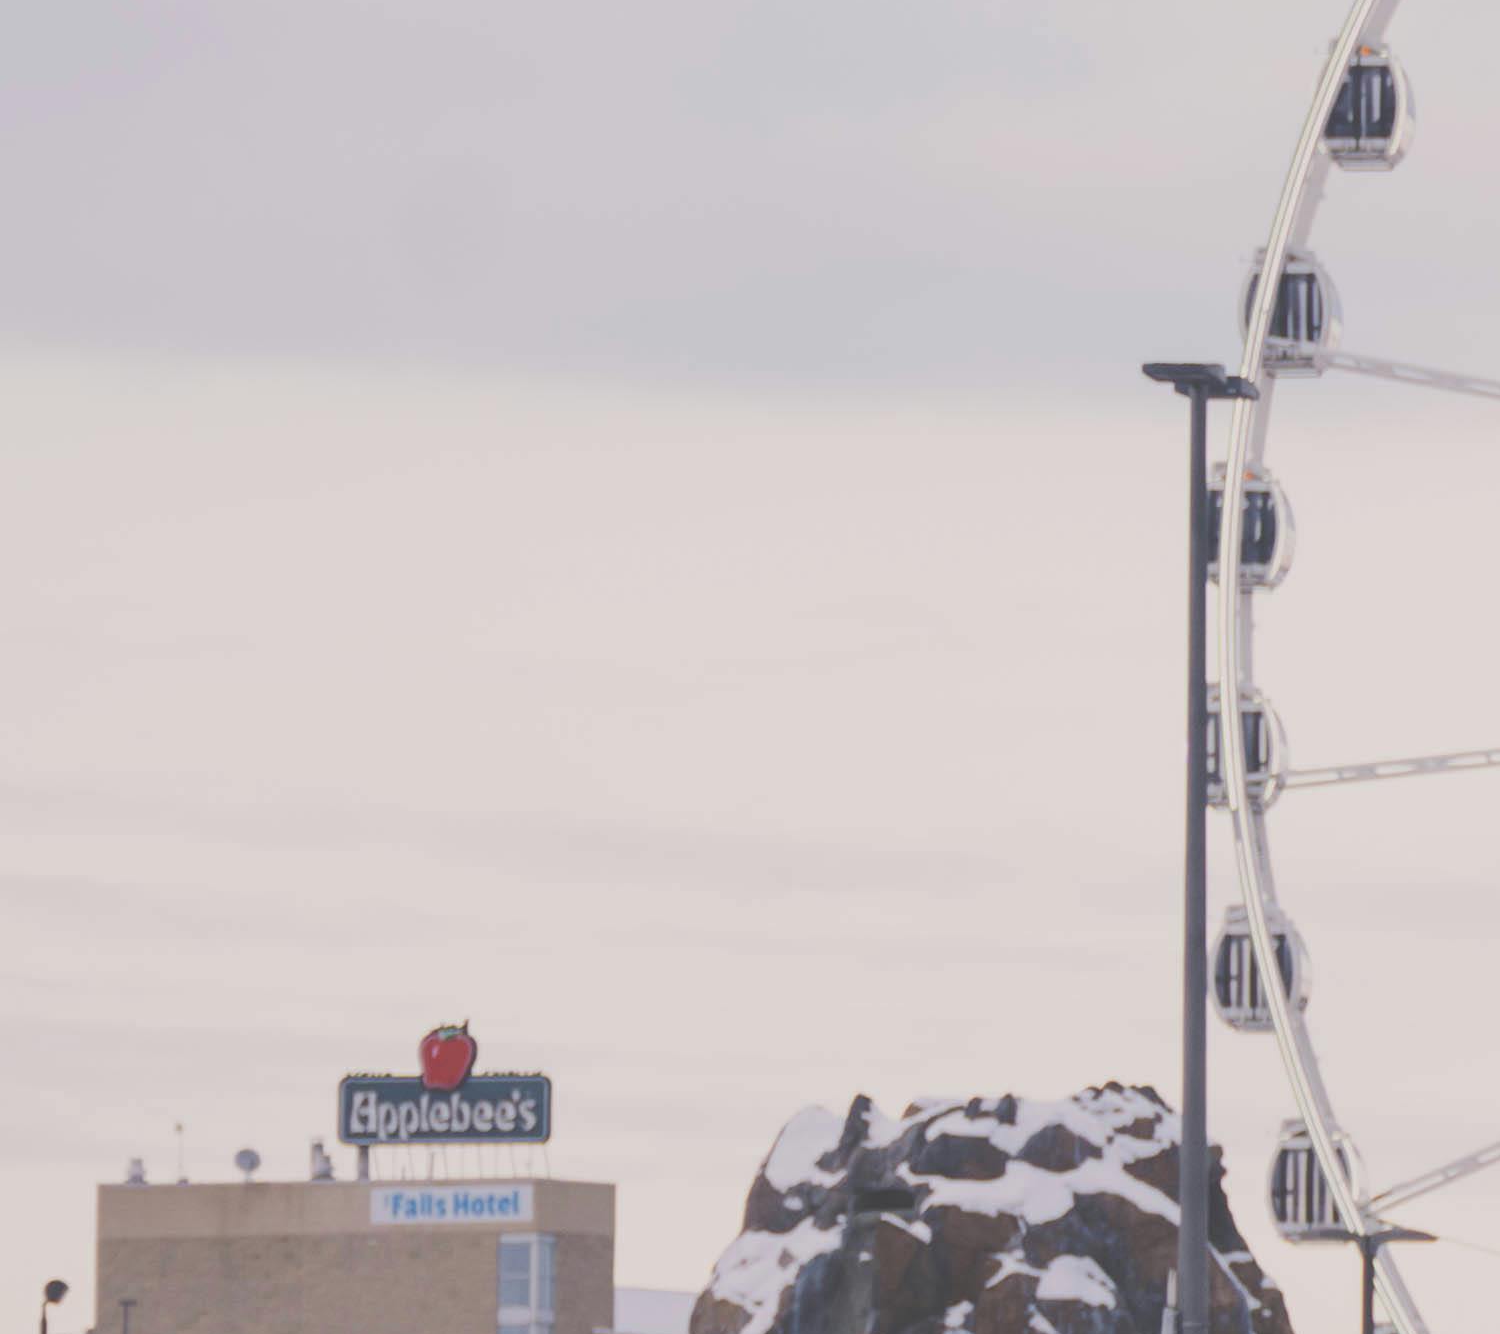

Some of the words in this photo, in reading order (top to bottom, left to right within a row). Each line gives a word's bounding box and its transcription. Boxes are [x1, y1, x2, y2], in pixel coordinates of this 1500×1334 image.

[350, 1089, 536, 1139] Applebee's
[390, 1192, 447, 1218] Falls
[453, 1190, 519, 1216] Hotel
